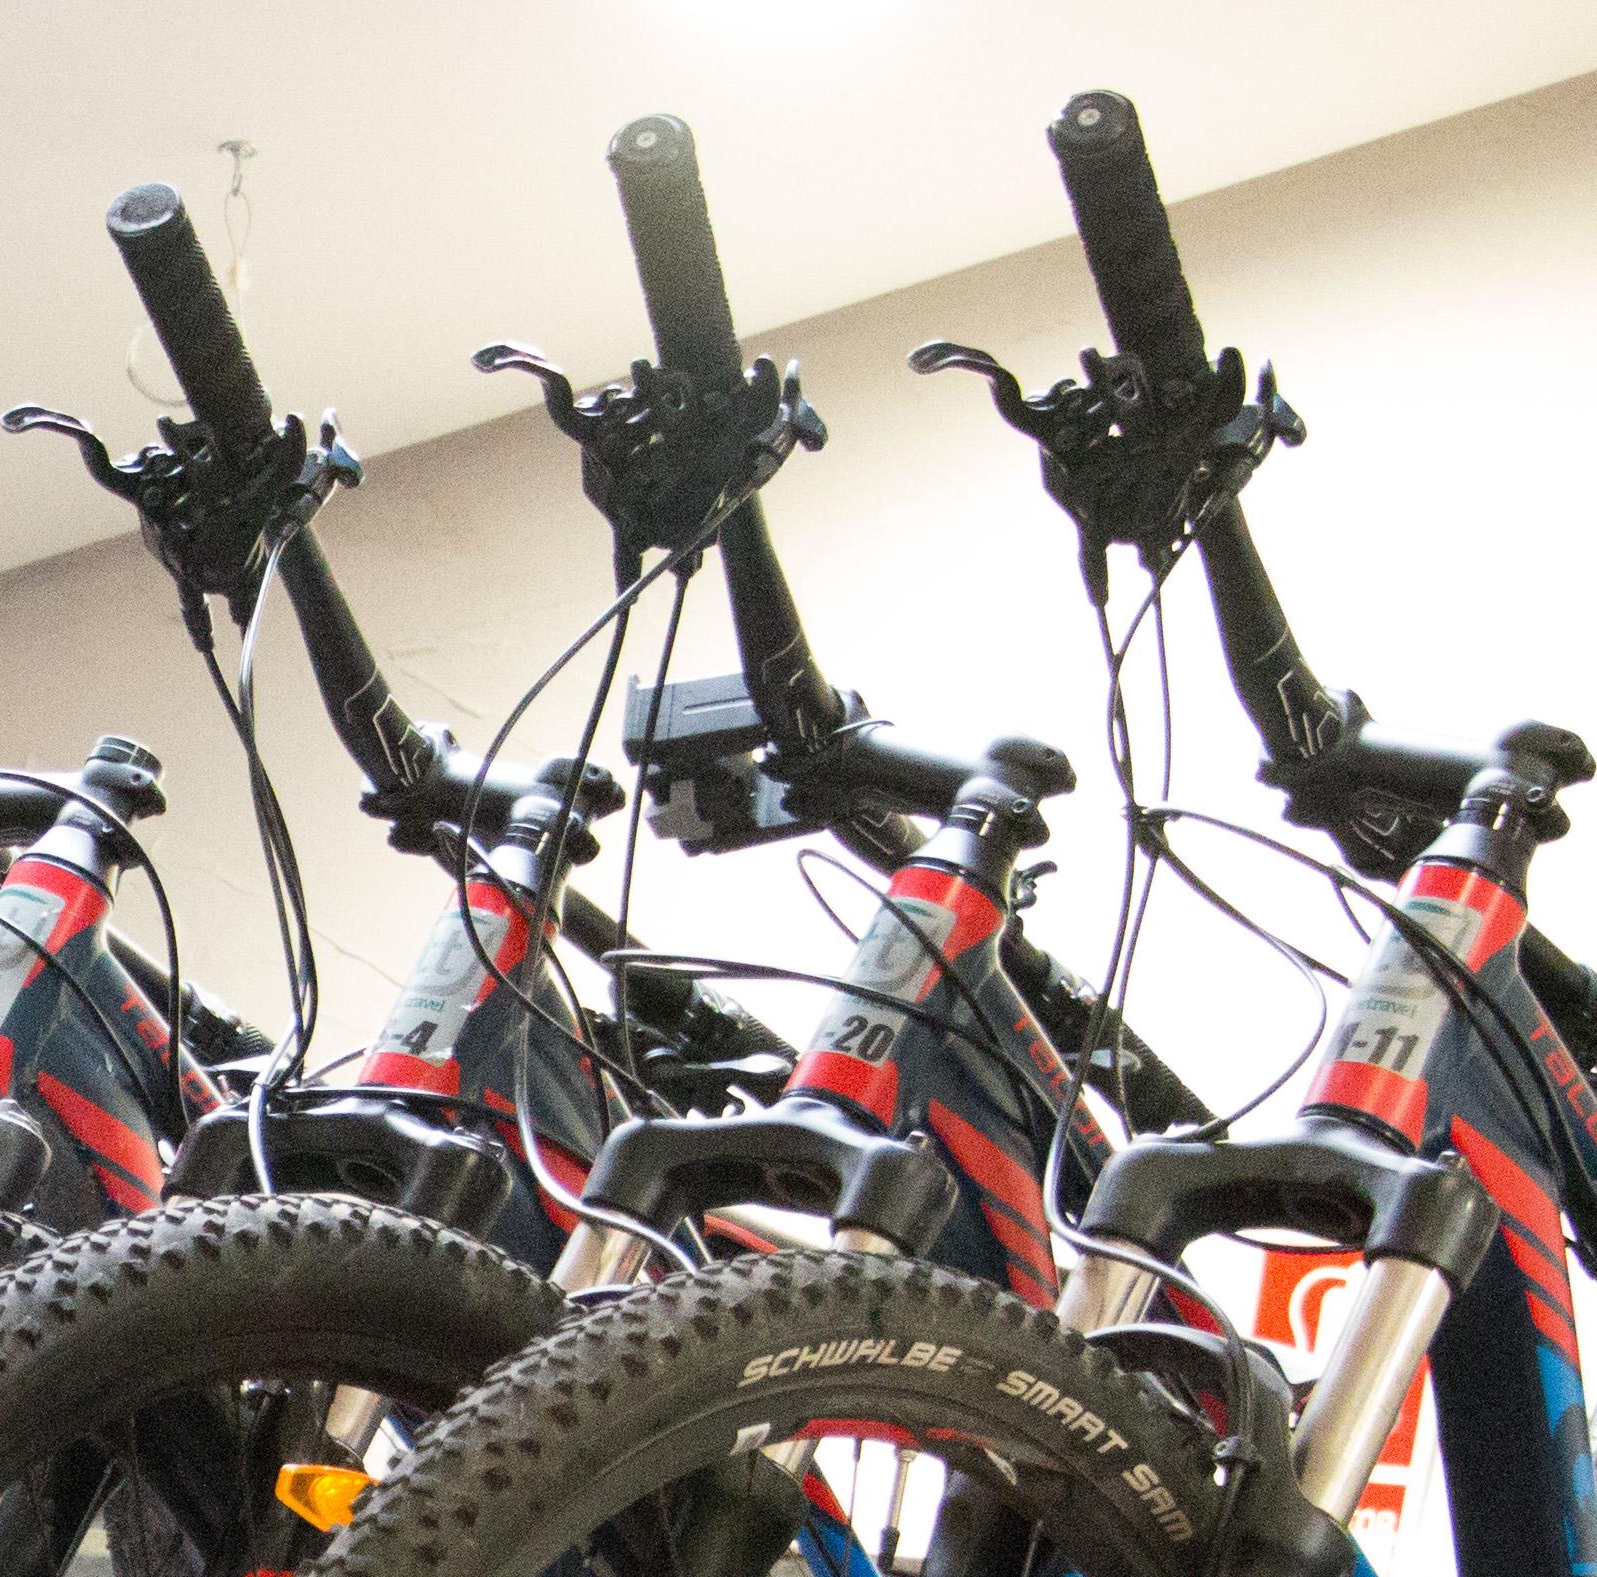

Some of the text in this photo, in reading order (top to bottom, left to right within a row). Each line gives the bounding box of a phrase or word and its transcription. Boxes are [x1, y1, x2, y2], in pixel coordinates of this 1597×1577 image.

[736, 1338, 1195, 1543] SCHWALBE SMART SAM
